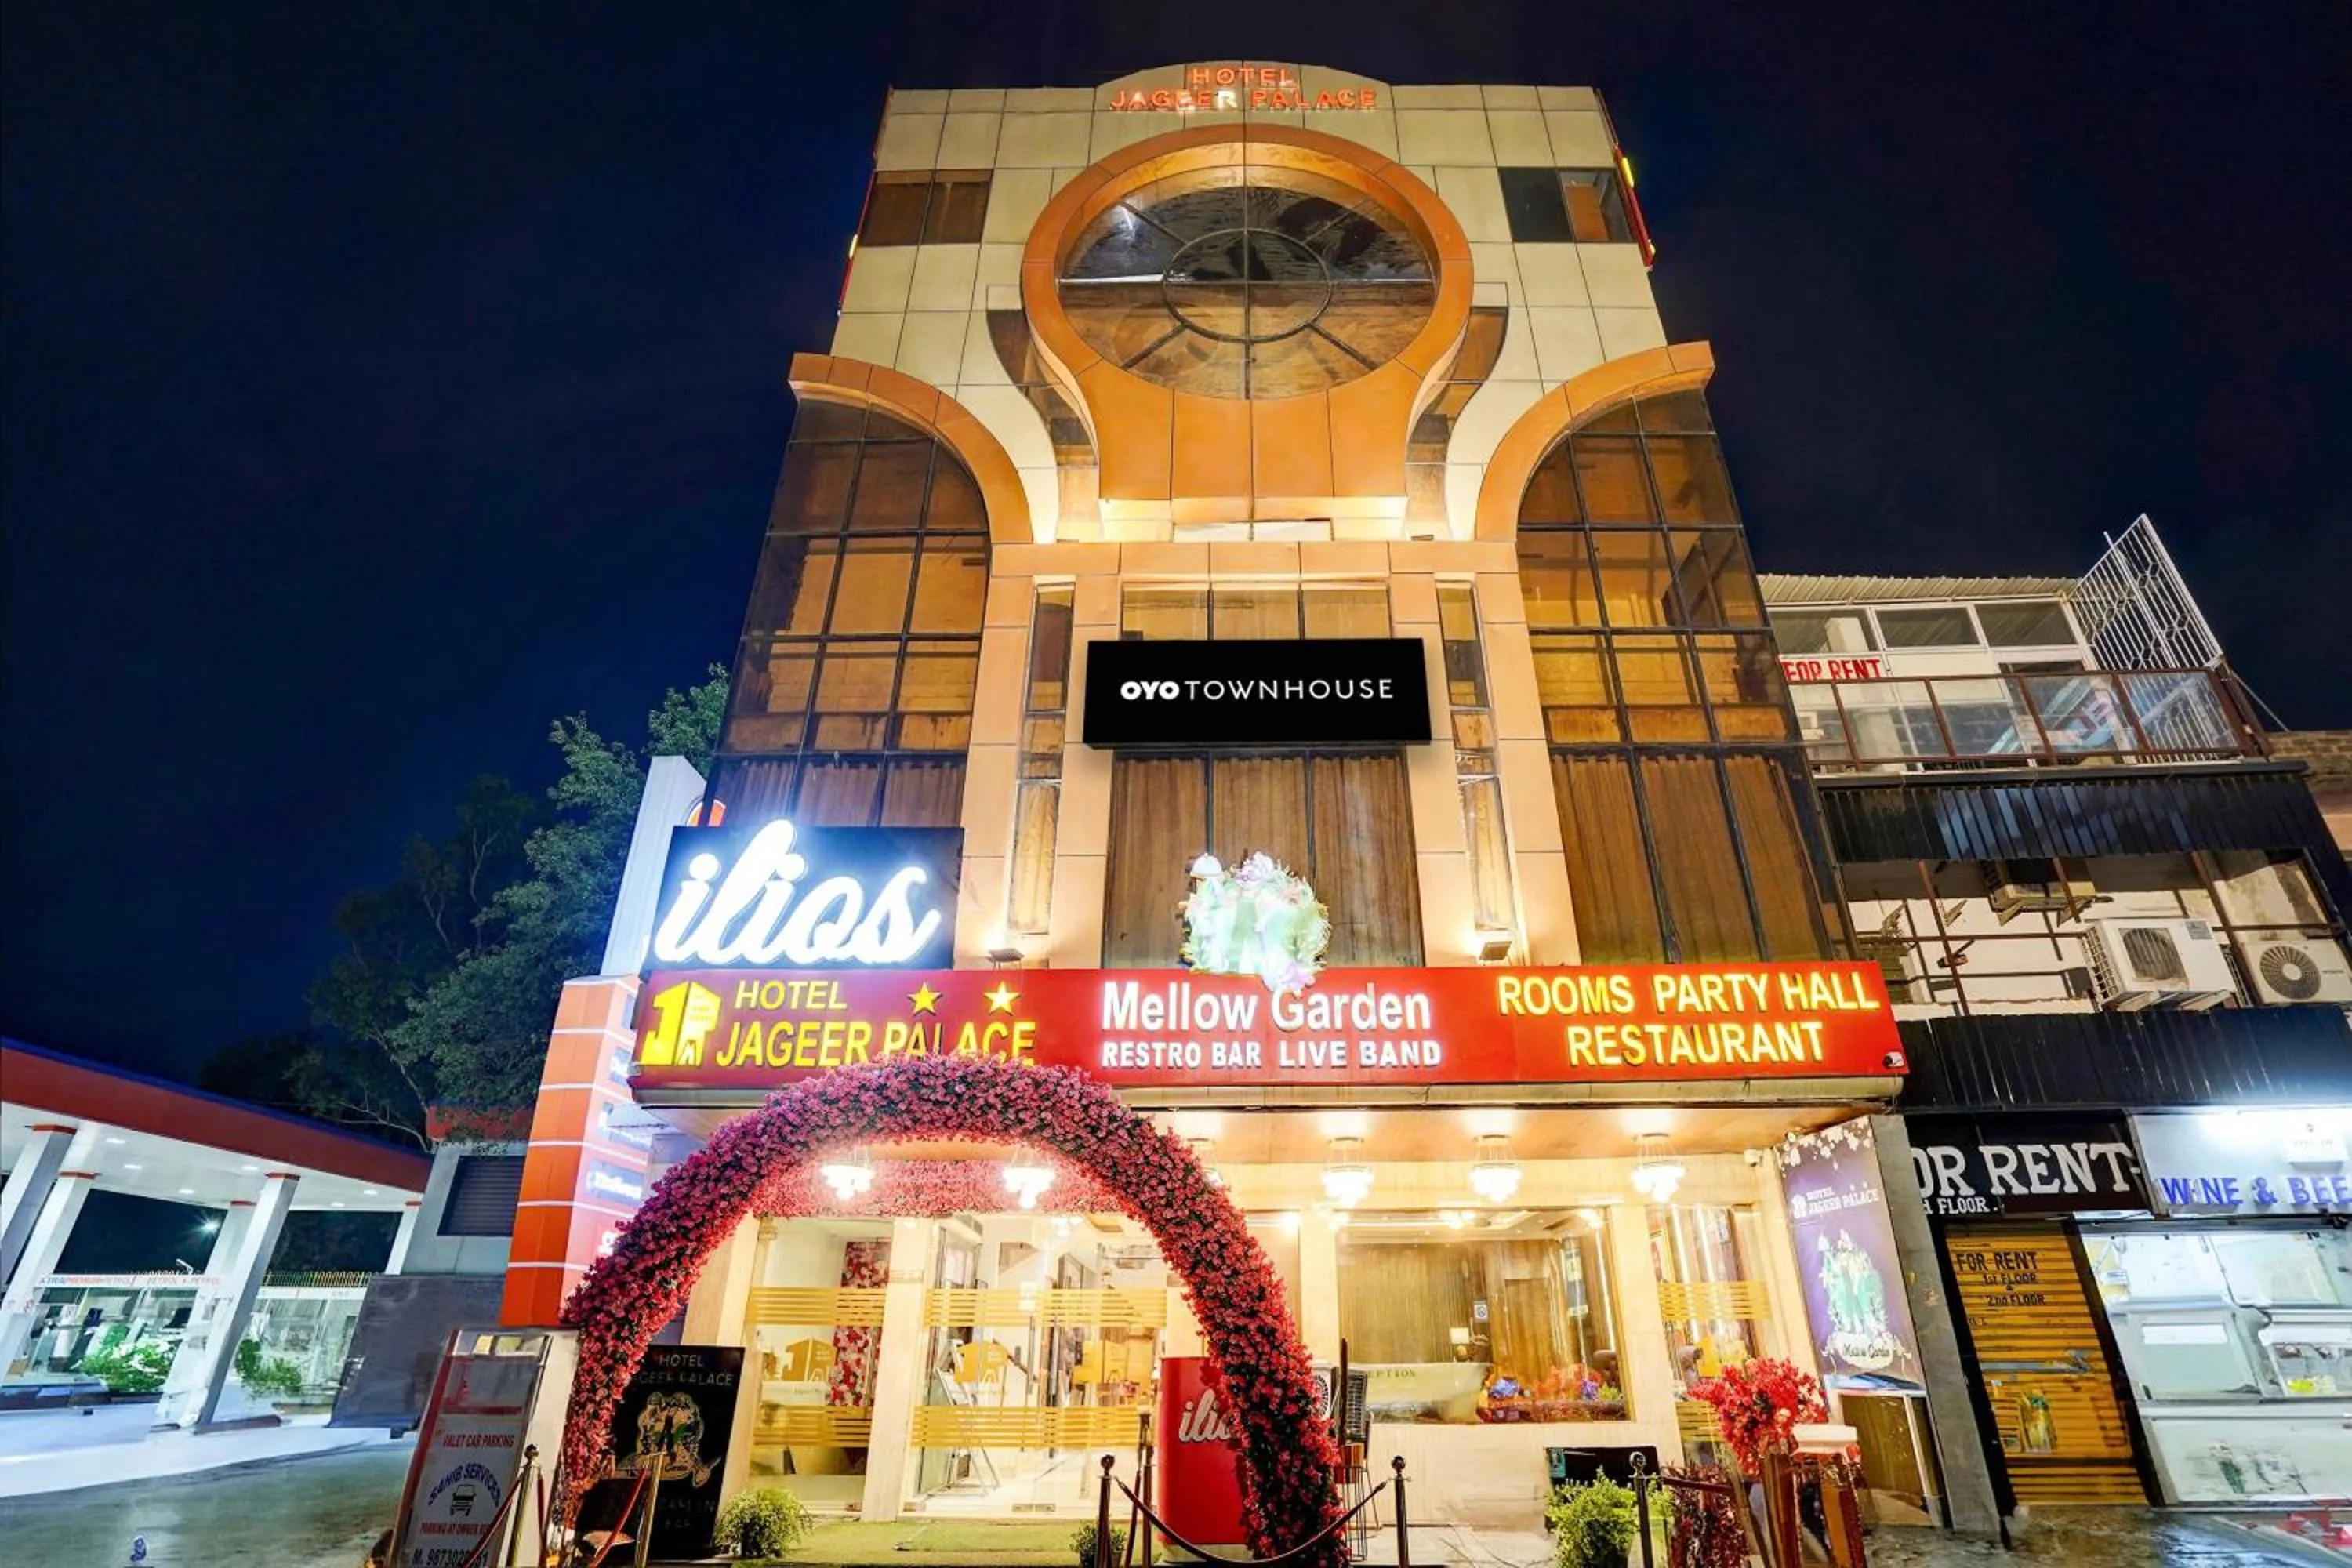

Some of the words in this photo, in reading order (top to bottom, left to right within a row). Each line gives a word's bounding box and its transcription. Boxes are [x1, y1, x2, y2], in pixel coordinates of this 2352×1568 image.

[1192, 67, 1298, 87] HOTEL
[1111, 89, 1237, 111] JAGEER
[1251, 89, 1378, 111] PALACE
[1782, 661, 1821, 681] FOR
[1828, 659, 1881, 681] RENT
[1120, 680, 1180, 700] OYO
[1185, 678, 1393, 700] TOWNHOUSE
[735, 979, 848, 1010] HOTEL
[1498, 976, 1635, 1016] ROOMS
[1652, 974, 1768, 1013] PARTY
[1780, 971, 1880, 1011] HALL
[1102, 981, 1258, 1032] Mellow
[1272, 982, 1432, 1032] Garden
[716, 1022, 872, 1068] JAGEER
[1102, 1042, 1201, 1068] RESTRO
[1212, 1042, 1261, 1068] BAR
[1279, 1041, 1347, 1068] LIVE
[1361, 1040, 1441, 1067] BAND
[1567, 1022, 1824, 1066] RESTAURANT
[2161, 1178, 2244, 1204] WNE
[1957, 1252, 1987, 1271] FOR
[1994, 1251, 2038, 1270] RENT
[2002, 1274, 2037, 1285] FLOOR
[2010, 1294, 2045, 1306] FLOOR
[659, 1354, 705, 1367] HOTEL
[483, 1434, 514, 1447] PARKING
